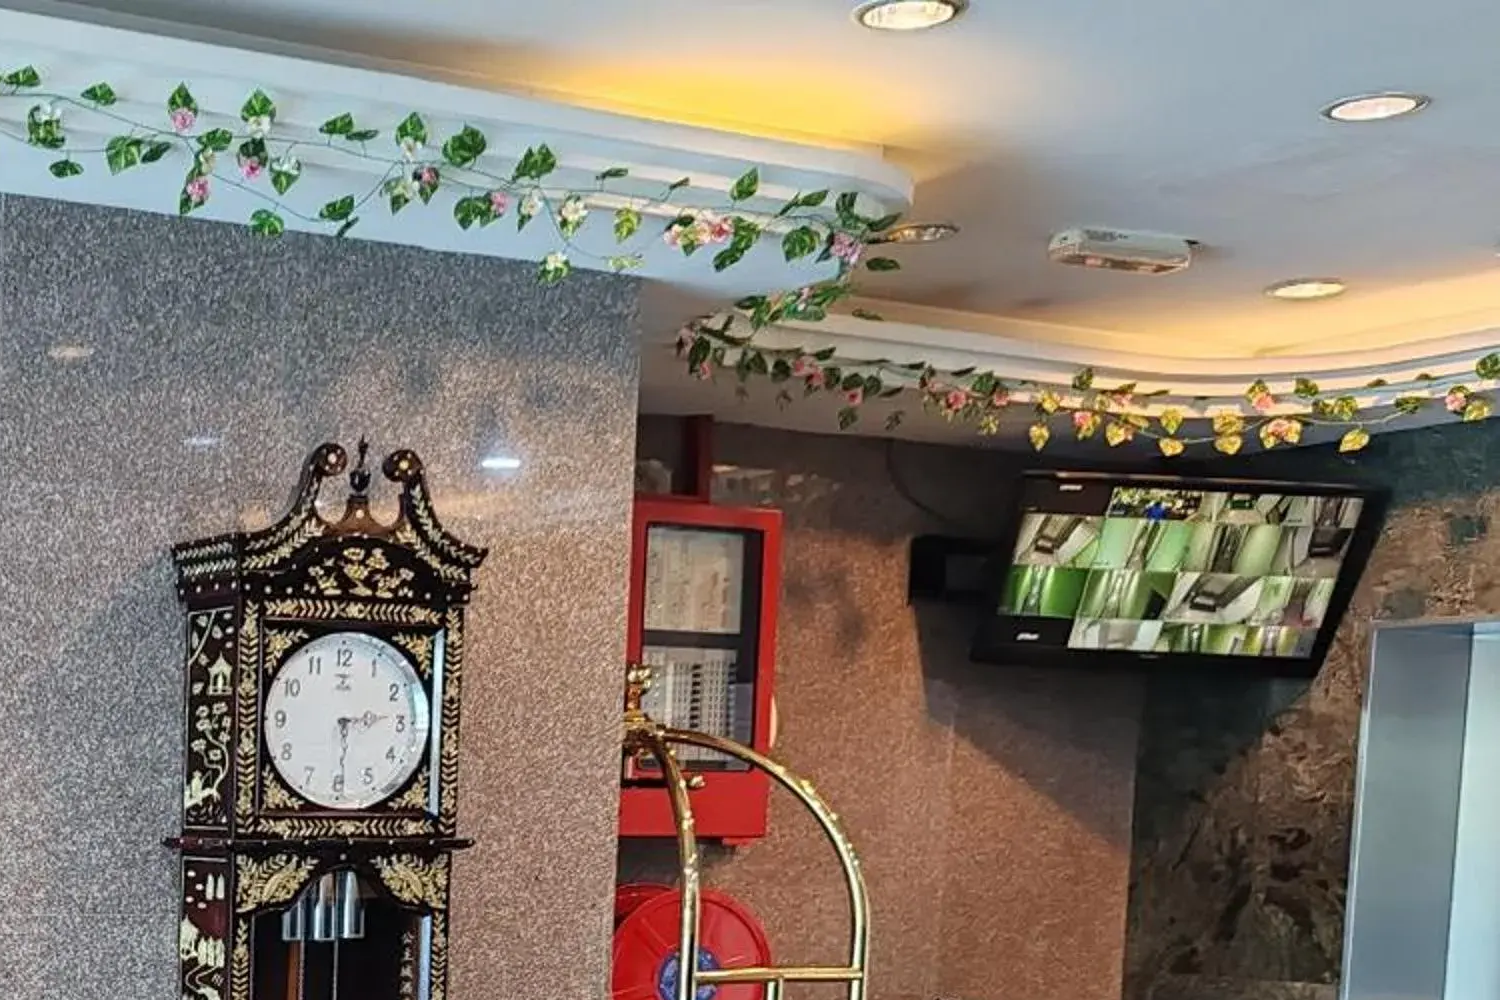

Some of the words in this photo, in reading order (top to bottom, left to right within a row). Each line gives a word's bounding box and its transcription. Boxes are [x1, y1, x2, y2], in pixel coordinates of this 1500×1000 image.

[308, 657, 322, 675] 11
[337, 648, 353, 667] 12
[371, 658, 377, 678] 1
[284, 679, 301, 697] 10
[389, 683, 399, 701] 2
[275, 710, 287, 728] 9
[395, 715, 405, 733] 3
[281, 742, 292, 761] 8
[386, 746, 396, 763] 4
[304, 766, 315, 785] 7
[332, 774, 344, 793] 6
[363, 767, 373, 785] 5
